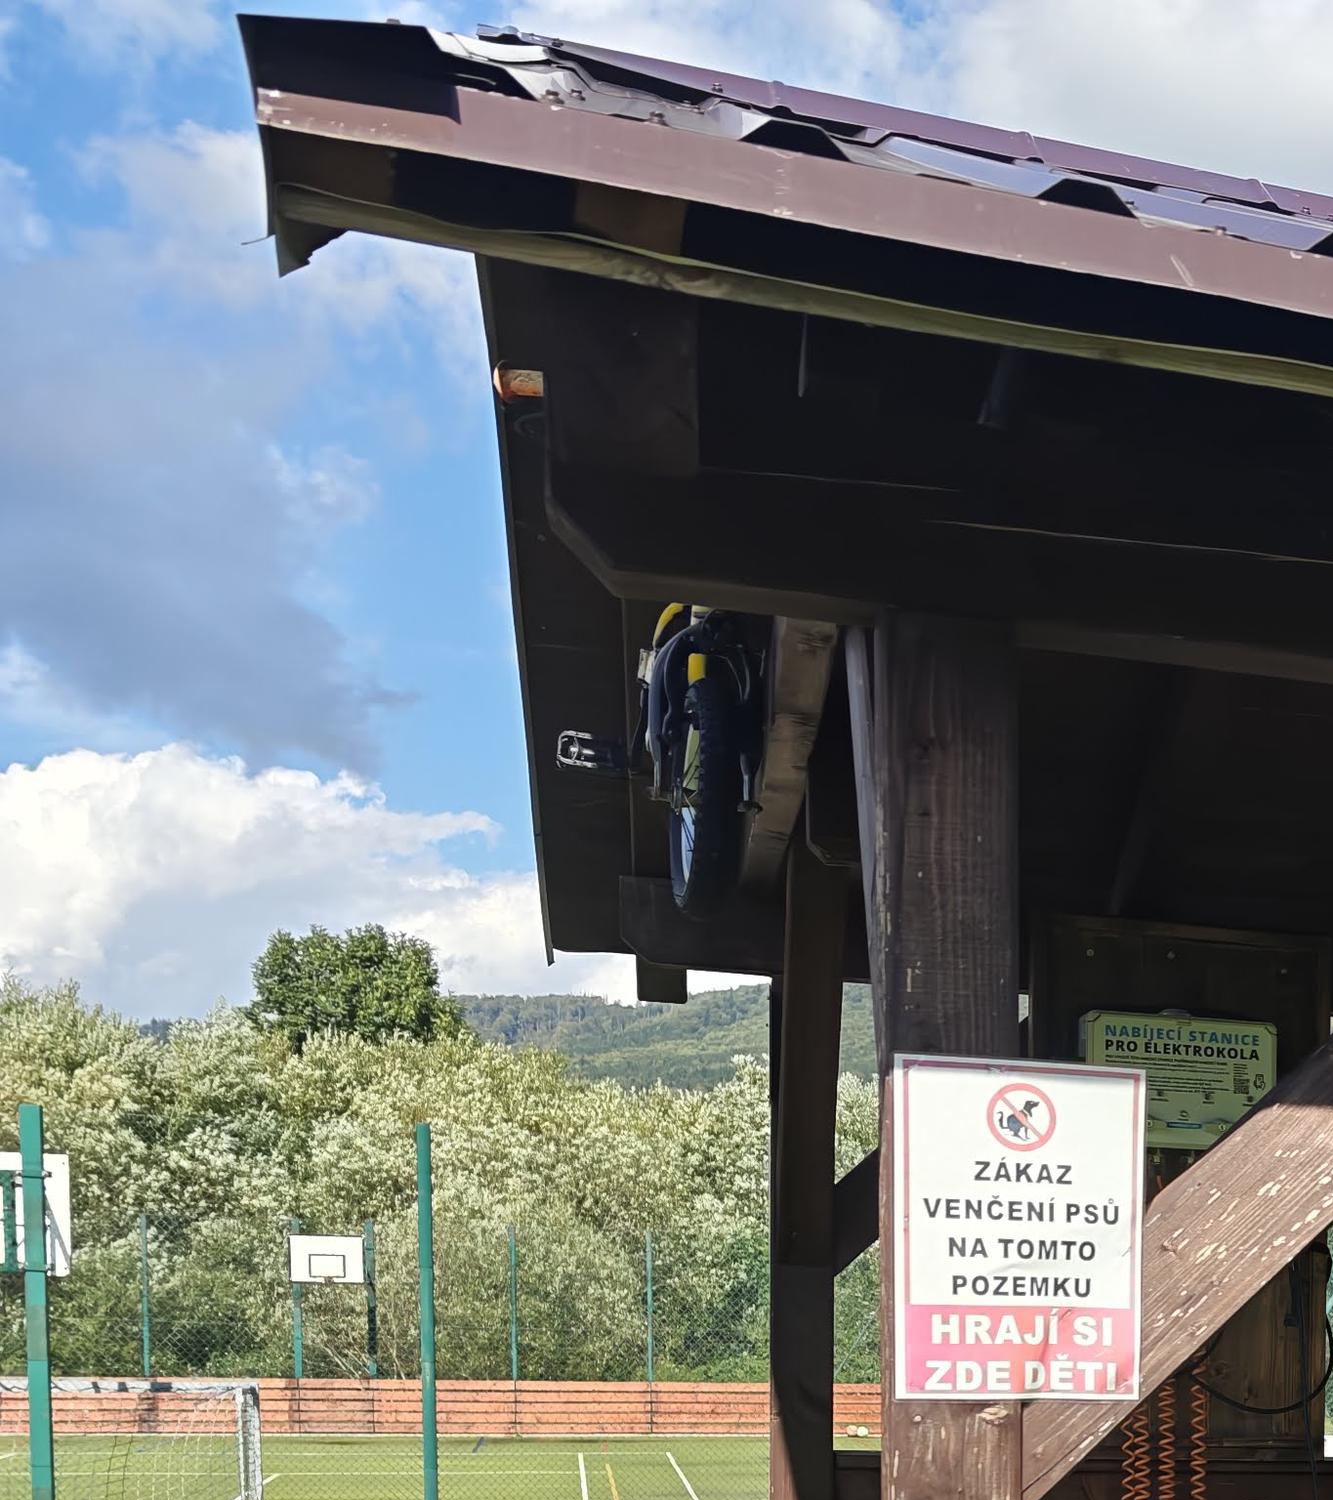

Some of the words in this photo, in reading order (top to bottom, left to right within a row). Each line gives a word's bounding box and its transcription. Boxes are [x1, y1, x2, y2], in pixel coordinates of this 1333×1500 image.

[1105, 1024, 1182, 1040] NABÍJECÍ
[1189, 1032, 1260, 1046] STANICE
[1105, 1039, 1138, 1052] PRO
[1144, 1043, 1260, 1061] ELEKTROKOLA
[973, 1157, 1073, 1185] ZÁKAZ
[923, 1194, 1056, 1224] VENČENÍ
[1065, 1198, 1120, 1225] PSŮ
[948, 1236, 989, 1259] NA
[997, 1238, 1097, 1263] TOMTO
[952, 1274, 1092, 1298] POZEMKU
[931, 1308, 1059, 1346] HRAJÍ
[1072, 1315, 1113, 1348] SI
[925, 1360, 1012, 1391] ZDE
[1023, 1353, 1117, 1392] DĚTI
